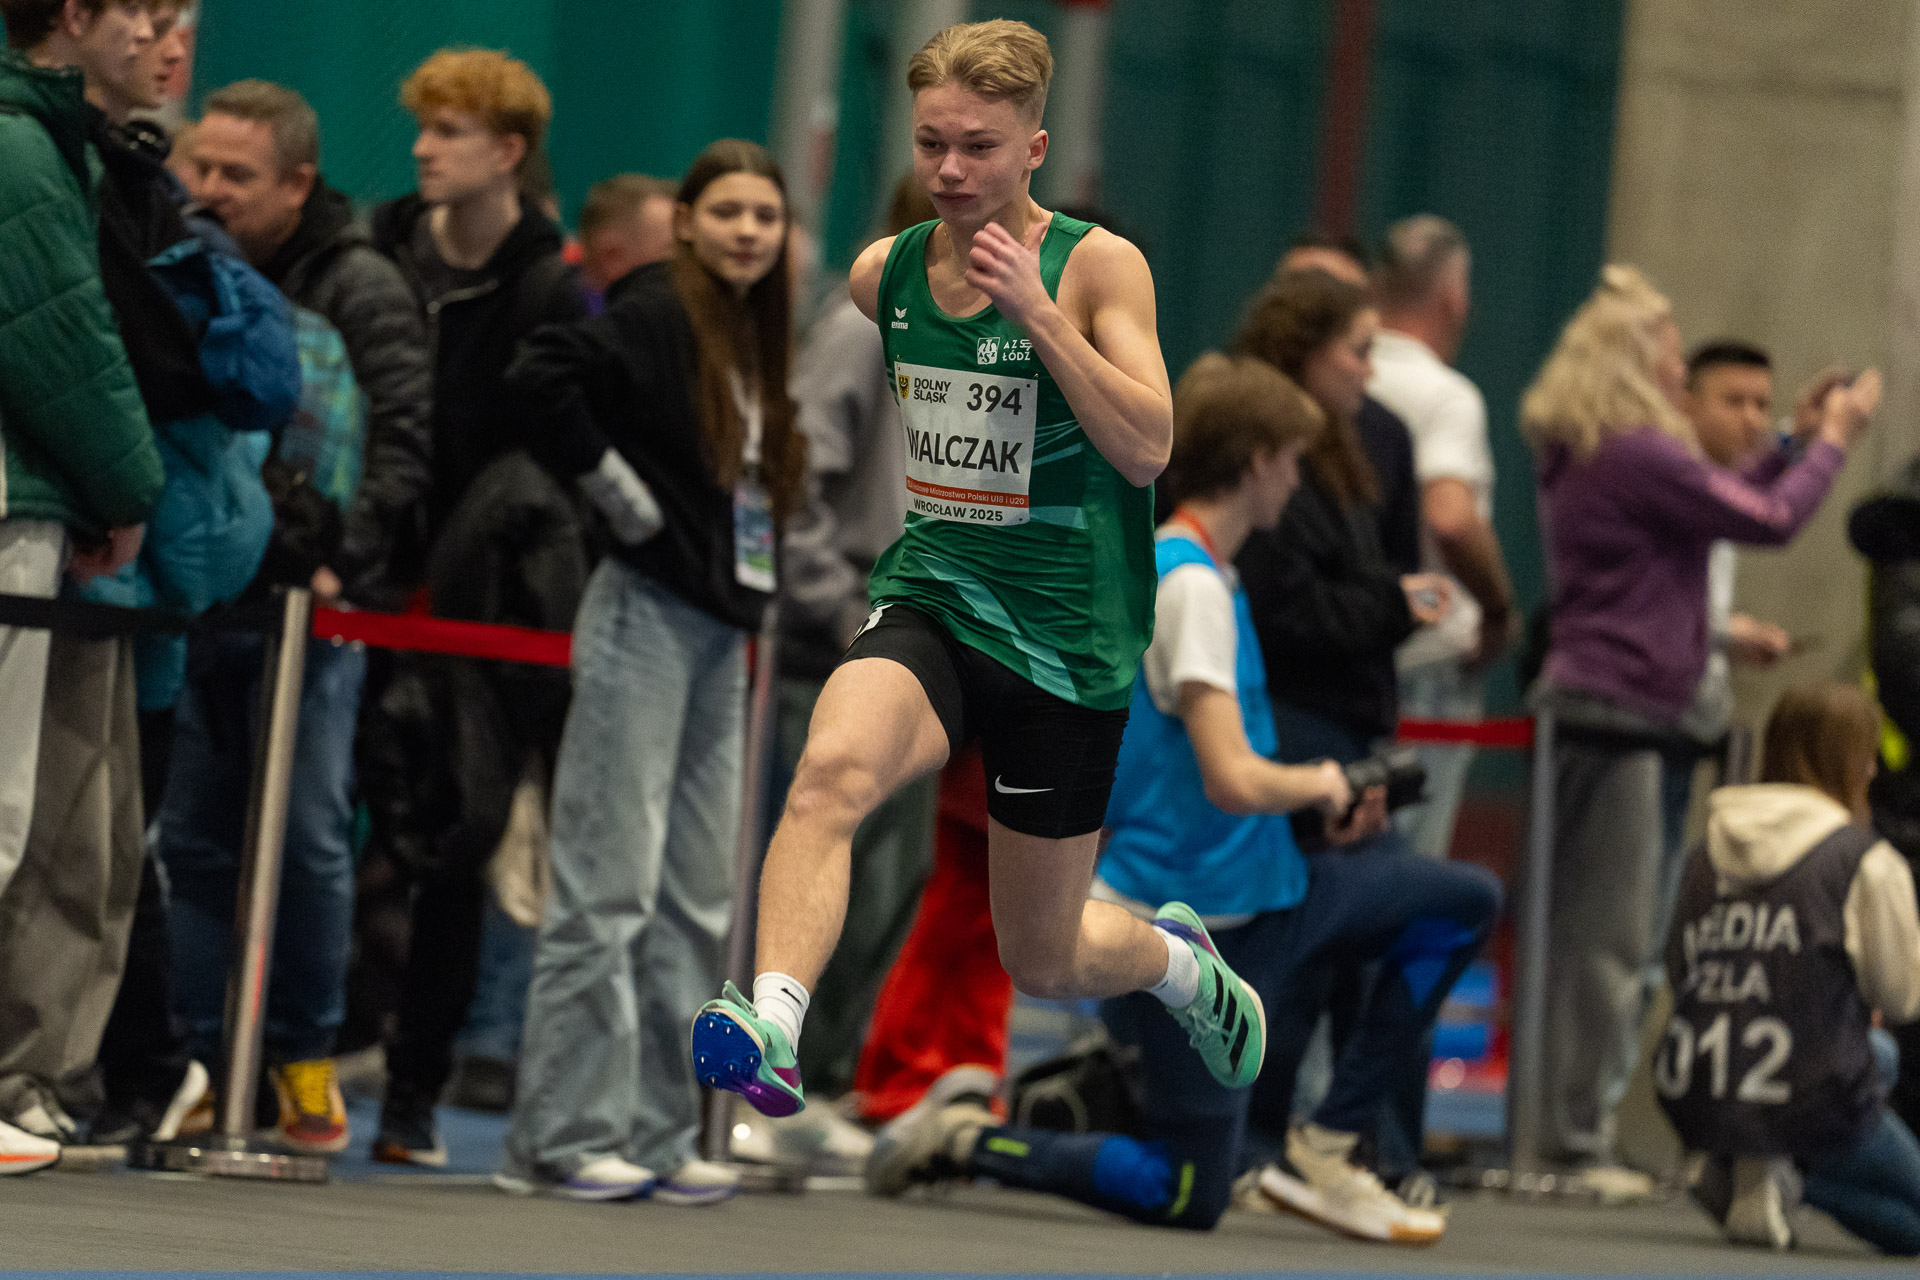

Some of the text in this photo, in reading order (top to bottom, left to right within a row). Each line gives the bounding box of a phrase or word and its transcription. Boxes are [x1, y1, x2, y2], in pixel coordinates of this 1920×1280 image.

[891, 320, 909, 330] erima
[913, 386, 948, 404] ŚLĄSK
[914, 377, 952, 392] DOLNY
[966, 382, 1023, 416] 394
[906, 425, 1023, 474] WALCZAK
[929, 487, 966, 499] Mistrzostwa
[967, 492, 990, 502] Polski
[990, 495, 1004, 504] U18
[1009, 497, 1025, 505] U20
[913, 498, 1004, 522] WROCŁAW 2025
[1684, 960, 1771, 1004] ZLA
[1655, 1012, 1793, 1104] 012
